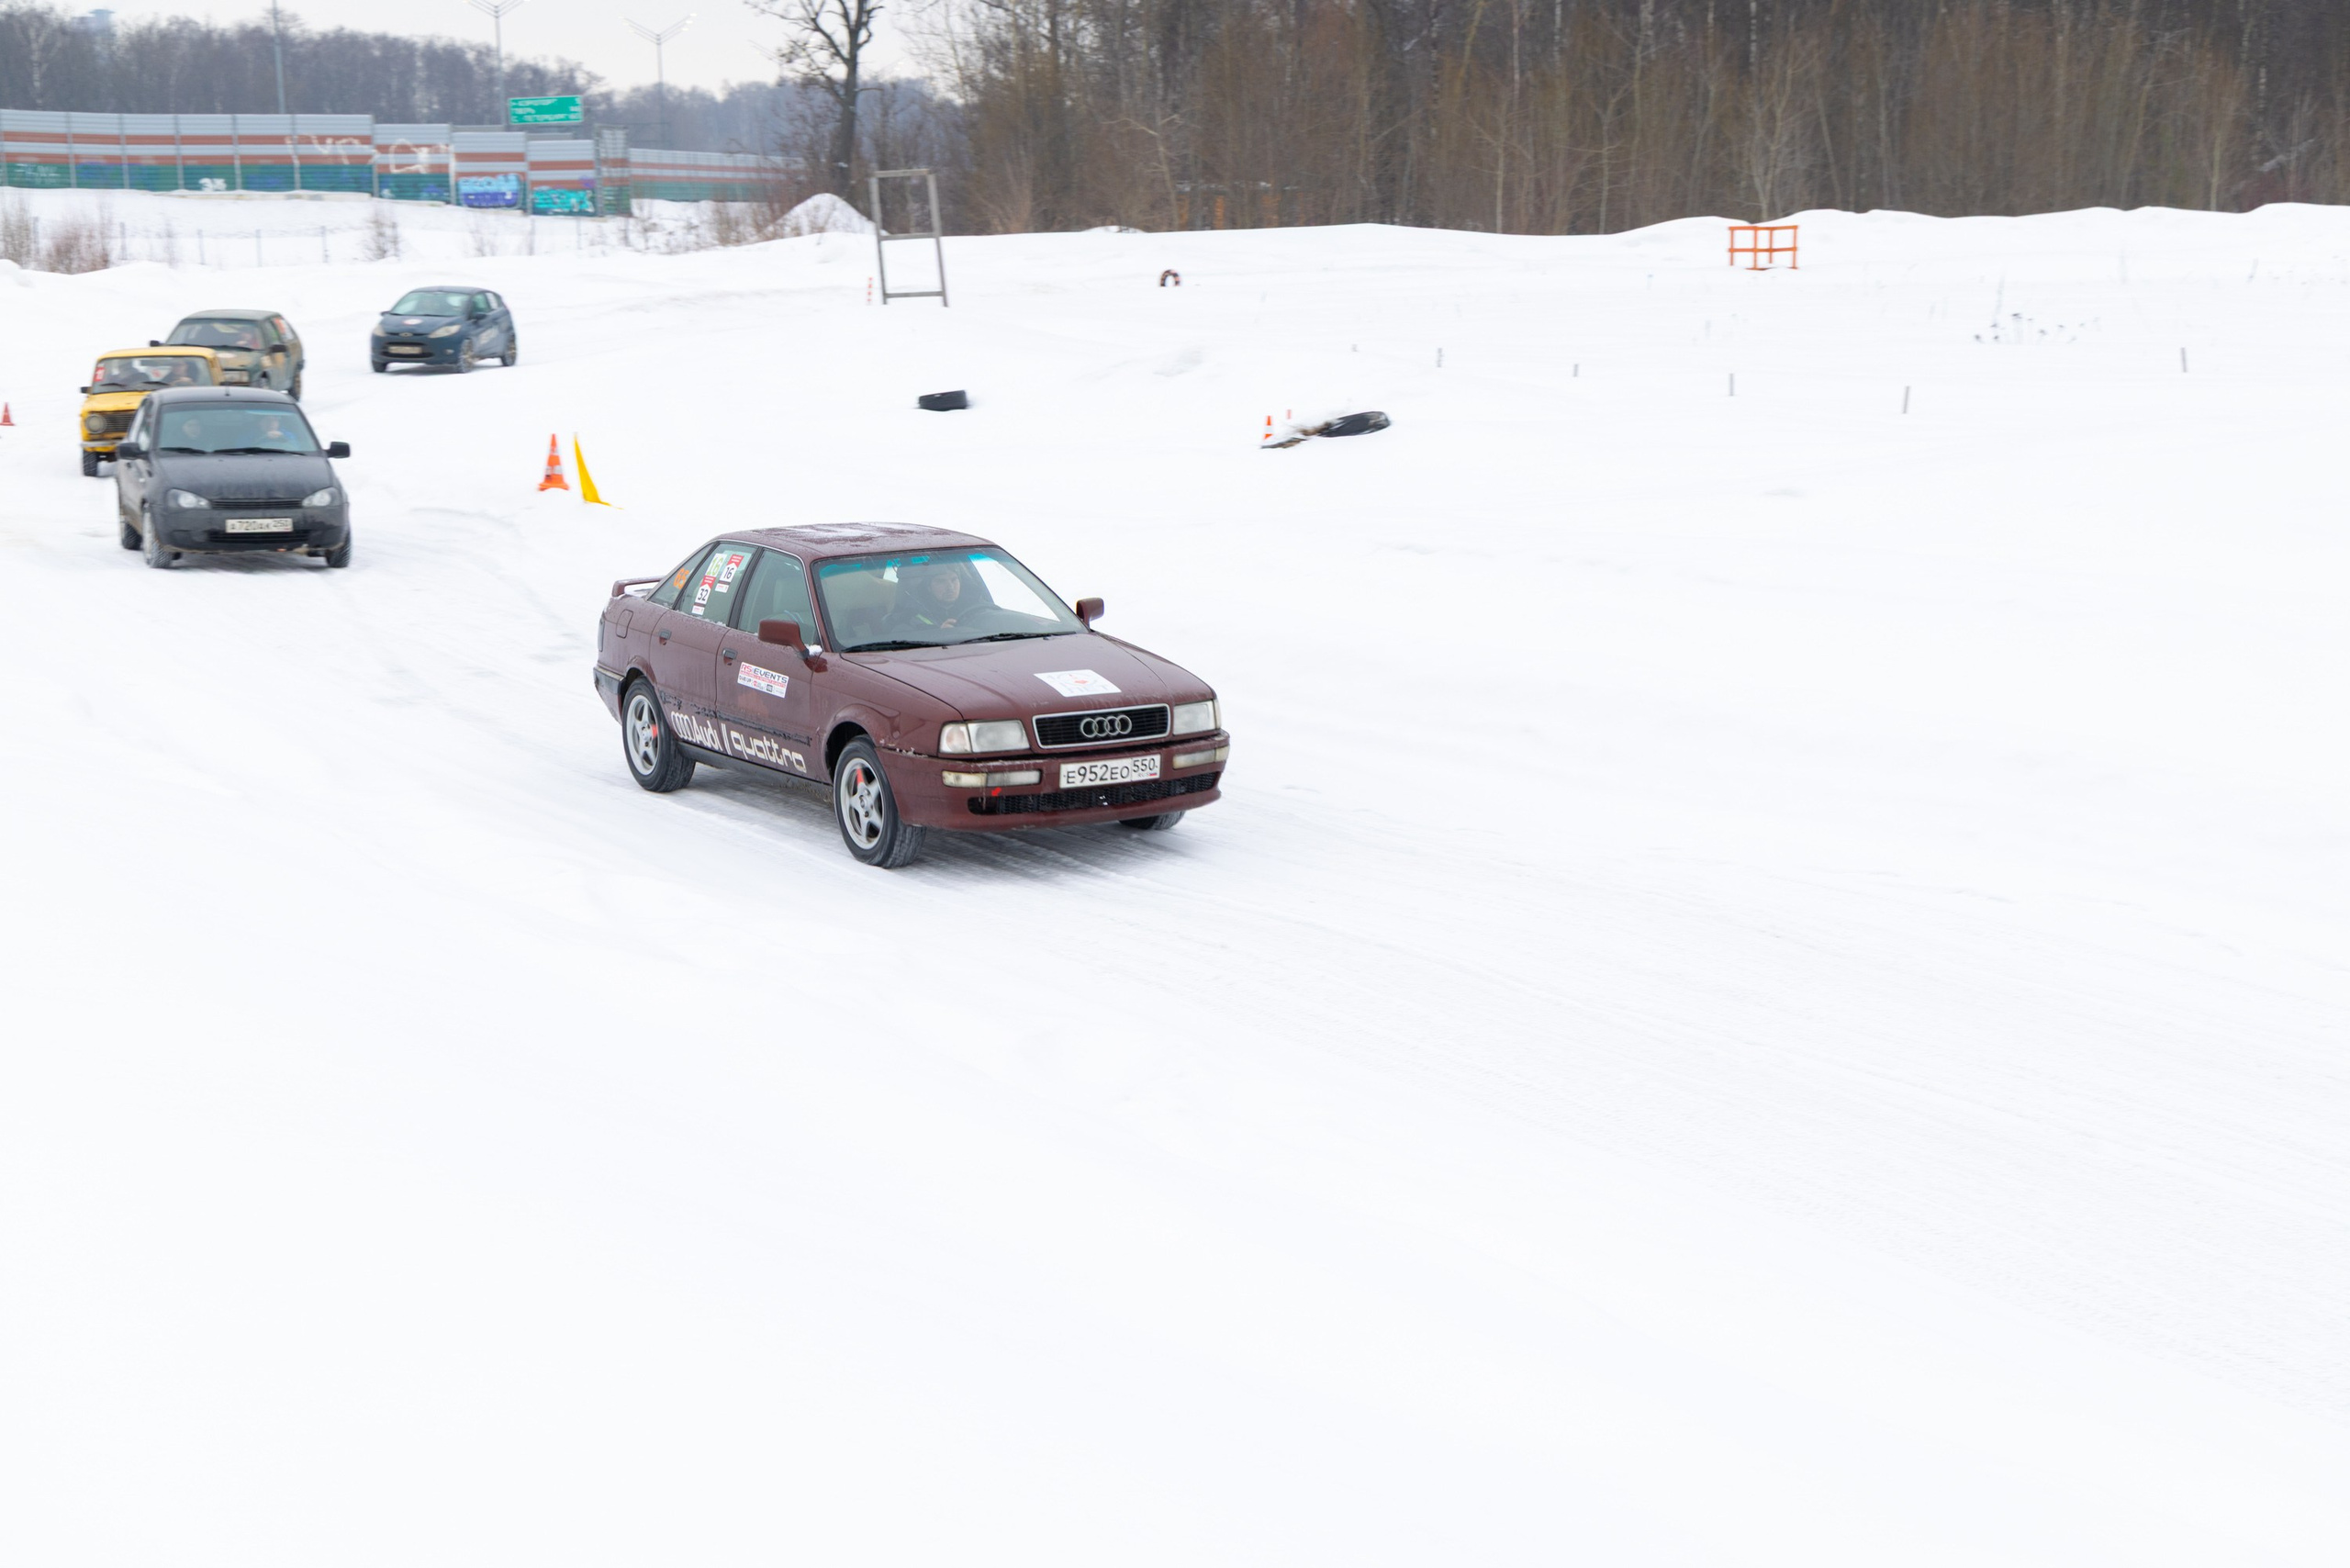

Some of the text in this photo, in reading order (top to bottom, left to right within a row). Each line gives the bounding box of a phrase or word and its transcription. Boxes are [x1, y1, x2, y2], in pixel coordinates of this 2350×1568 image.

[706, 555, 724, 576] 16
[723, 566, 734, 579] 16
[698, 588, 709, 601] 32
[741, 664, 753, 673] RS
[753, 667, 788, 683] EVENTS
[691, 715, 807, 774] Audi quattro
[1132, 757, 1156, 773] 550
